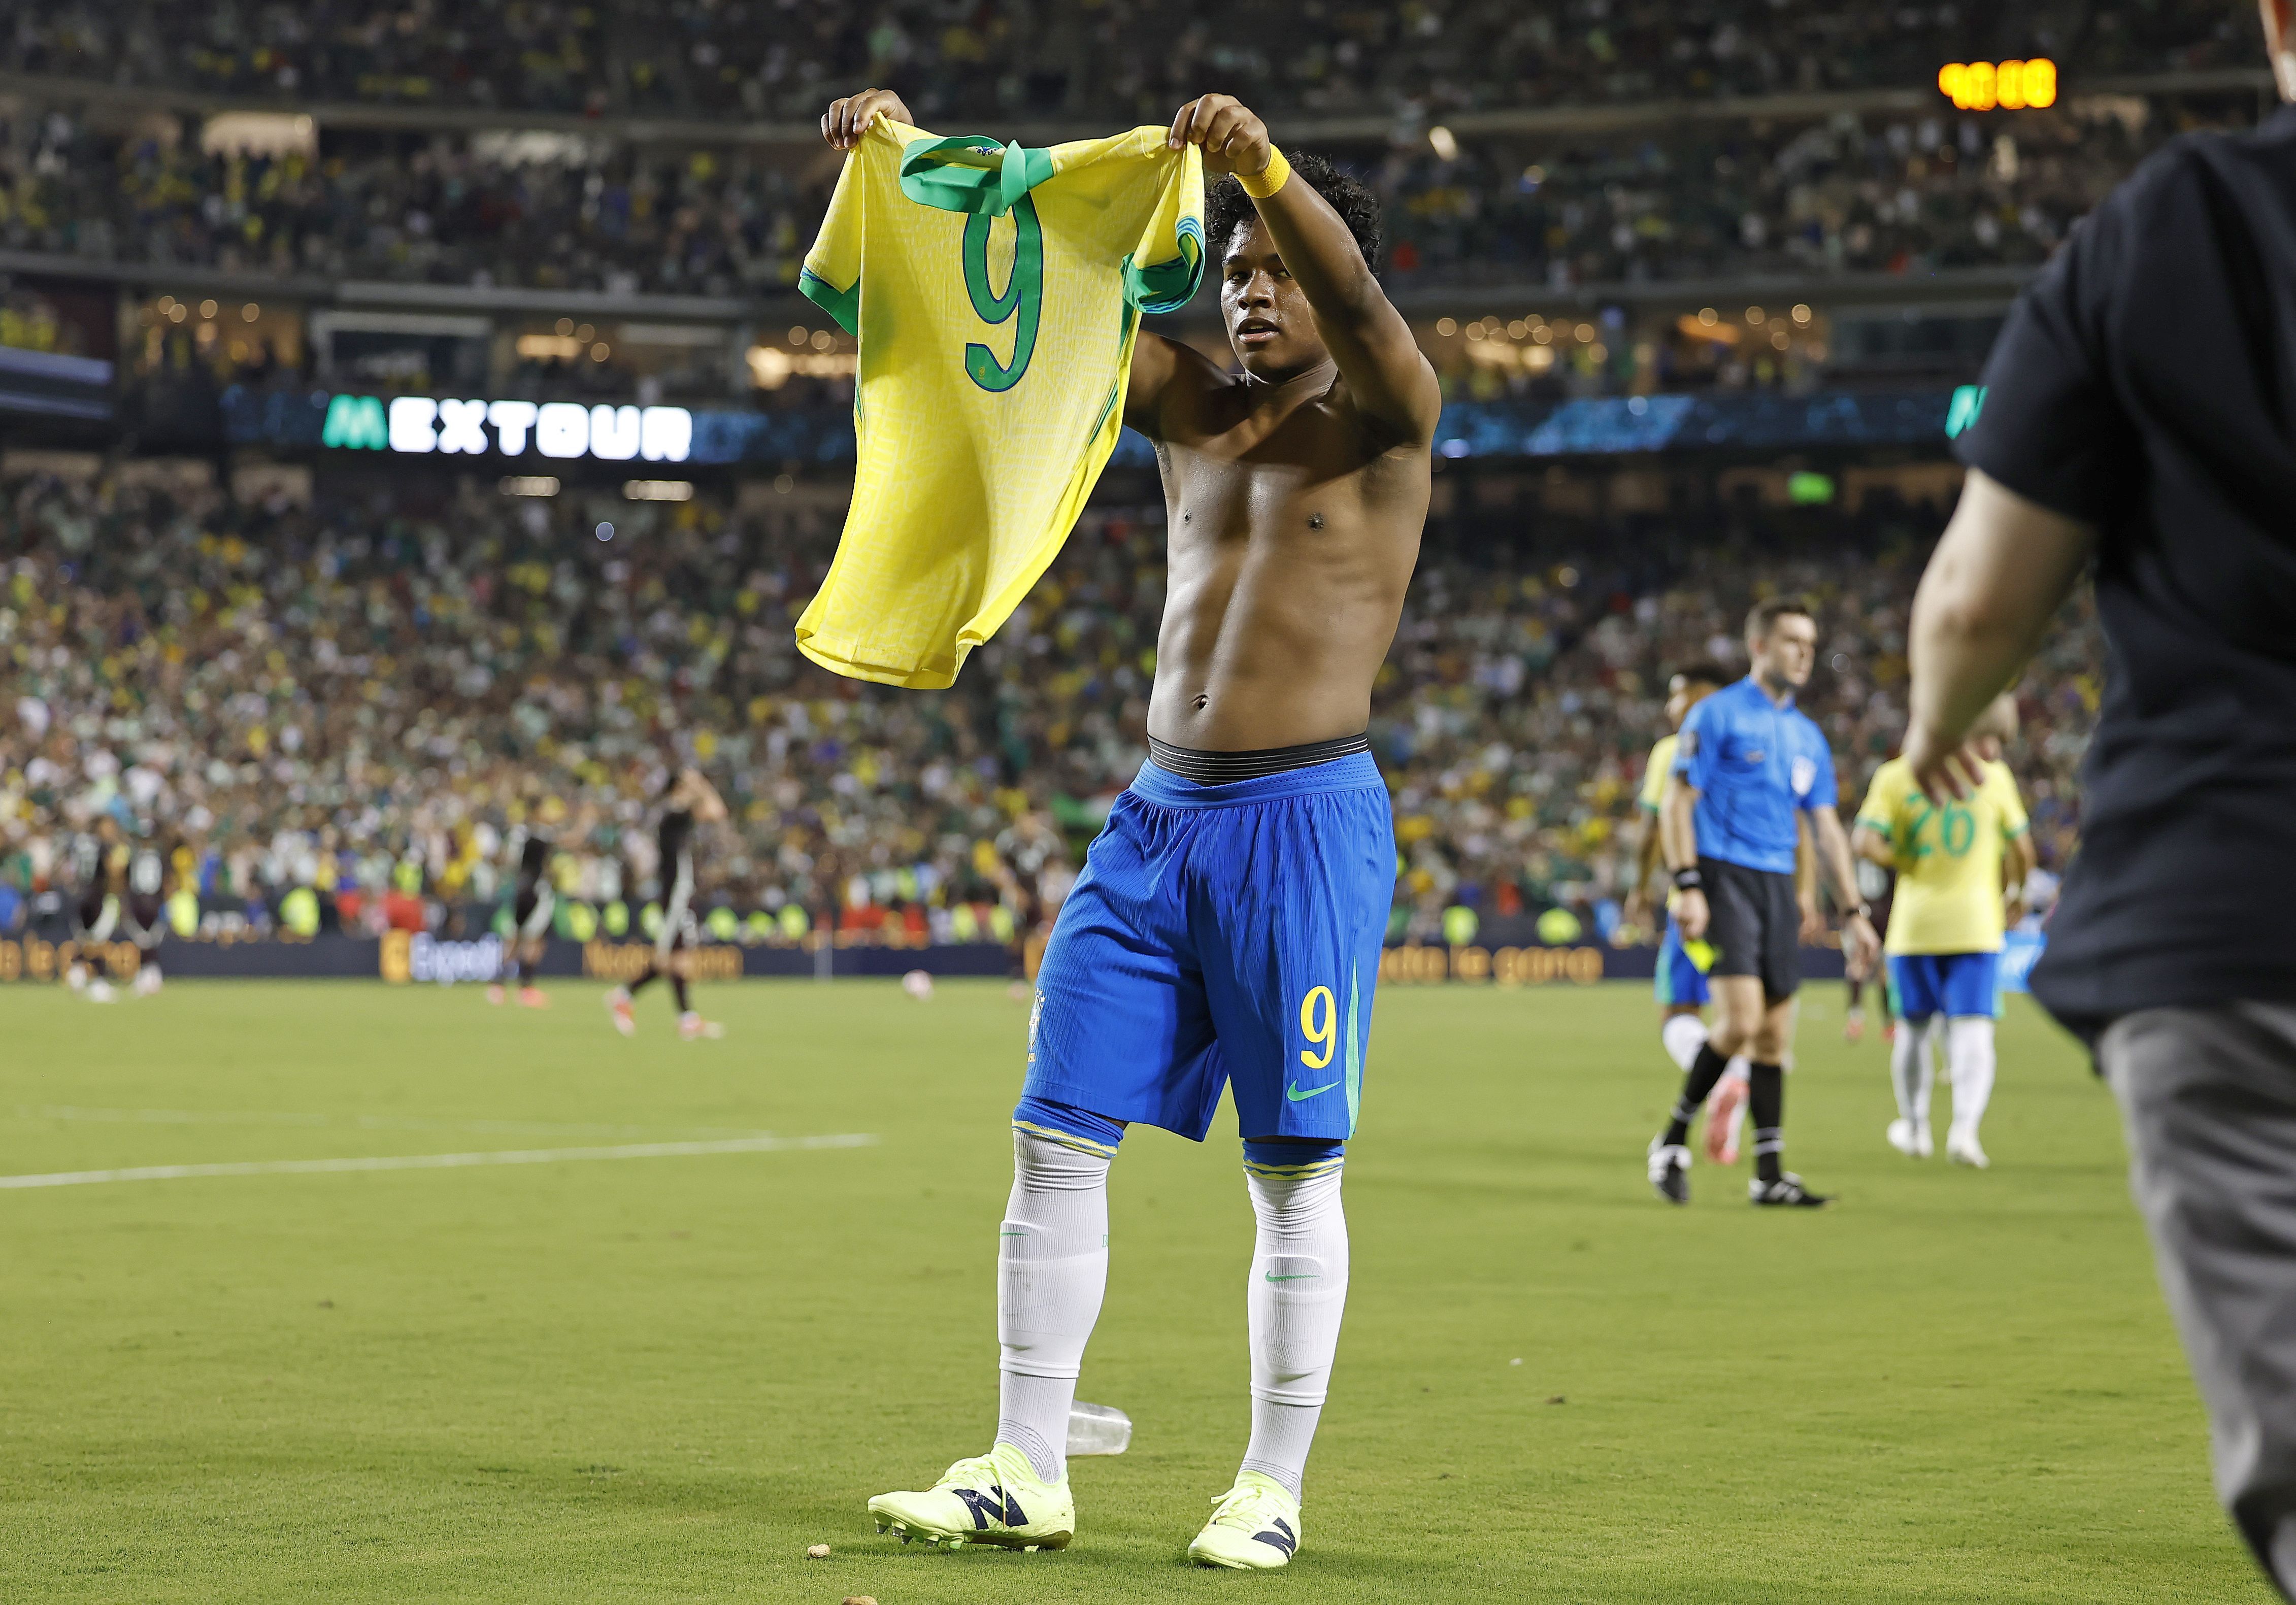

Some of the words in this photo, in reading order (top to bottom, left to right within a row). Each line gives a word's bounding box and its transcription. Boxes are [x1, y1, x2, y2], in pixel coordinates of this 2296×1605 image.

[962, 190, 1044, 393] 9
[322, 393, 693, 462] MEXTOUR
[1301, 985, 1337, 1069] 9
